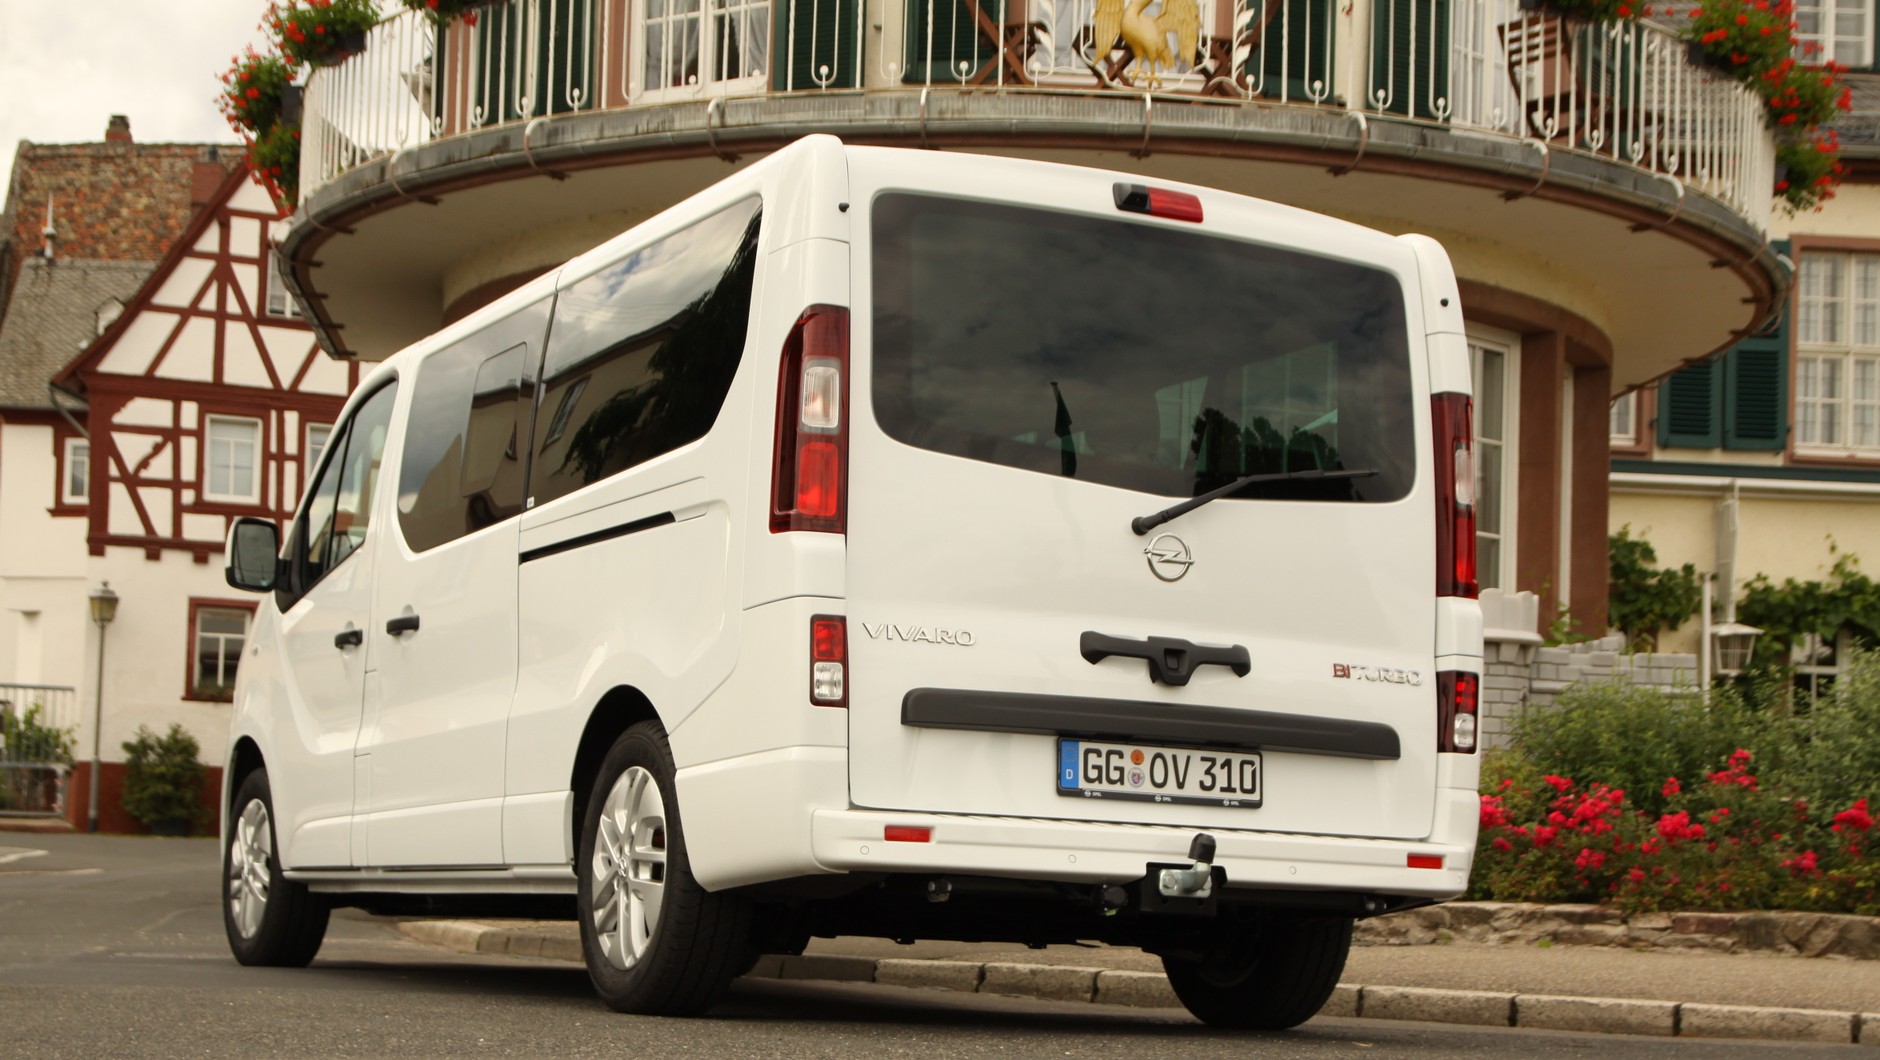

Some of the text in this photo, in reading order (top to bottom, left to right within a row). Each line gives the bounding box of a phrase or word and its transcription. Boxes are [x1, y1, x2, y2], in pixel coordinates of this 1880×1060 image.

[862, 622, 976, 646] VIVARO
[1333, 663, 1422, 686] BITURBO
[1065, 768, 1074, 780] D
[1083, 747, 1125, 786] GG
[1199, 756, 1257, 794] 310
